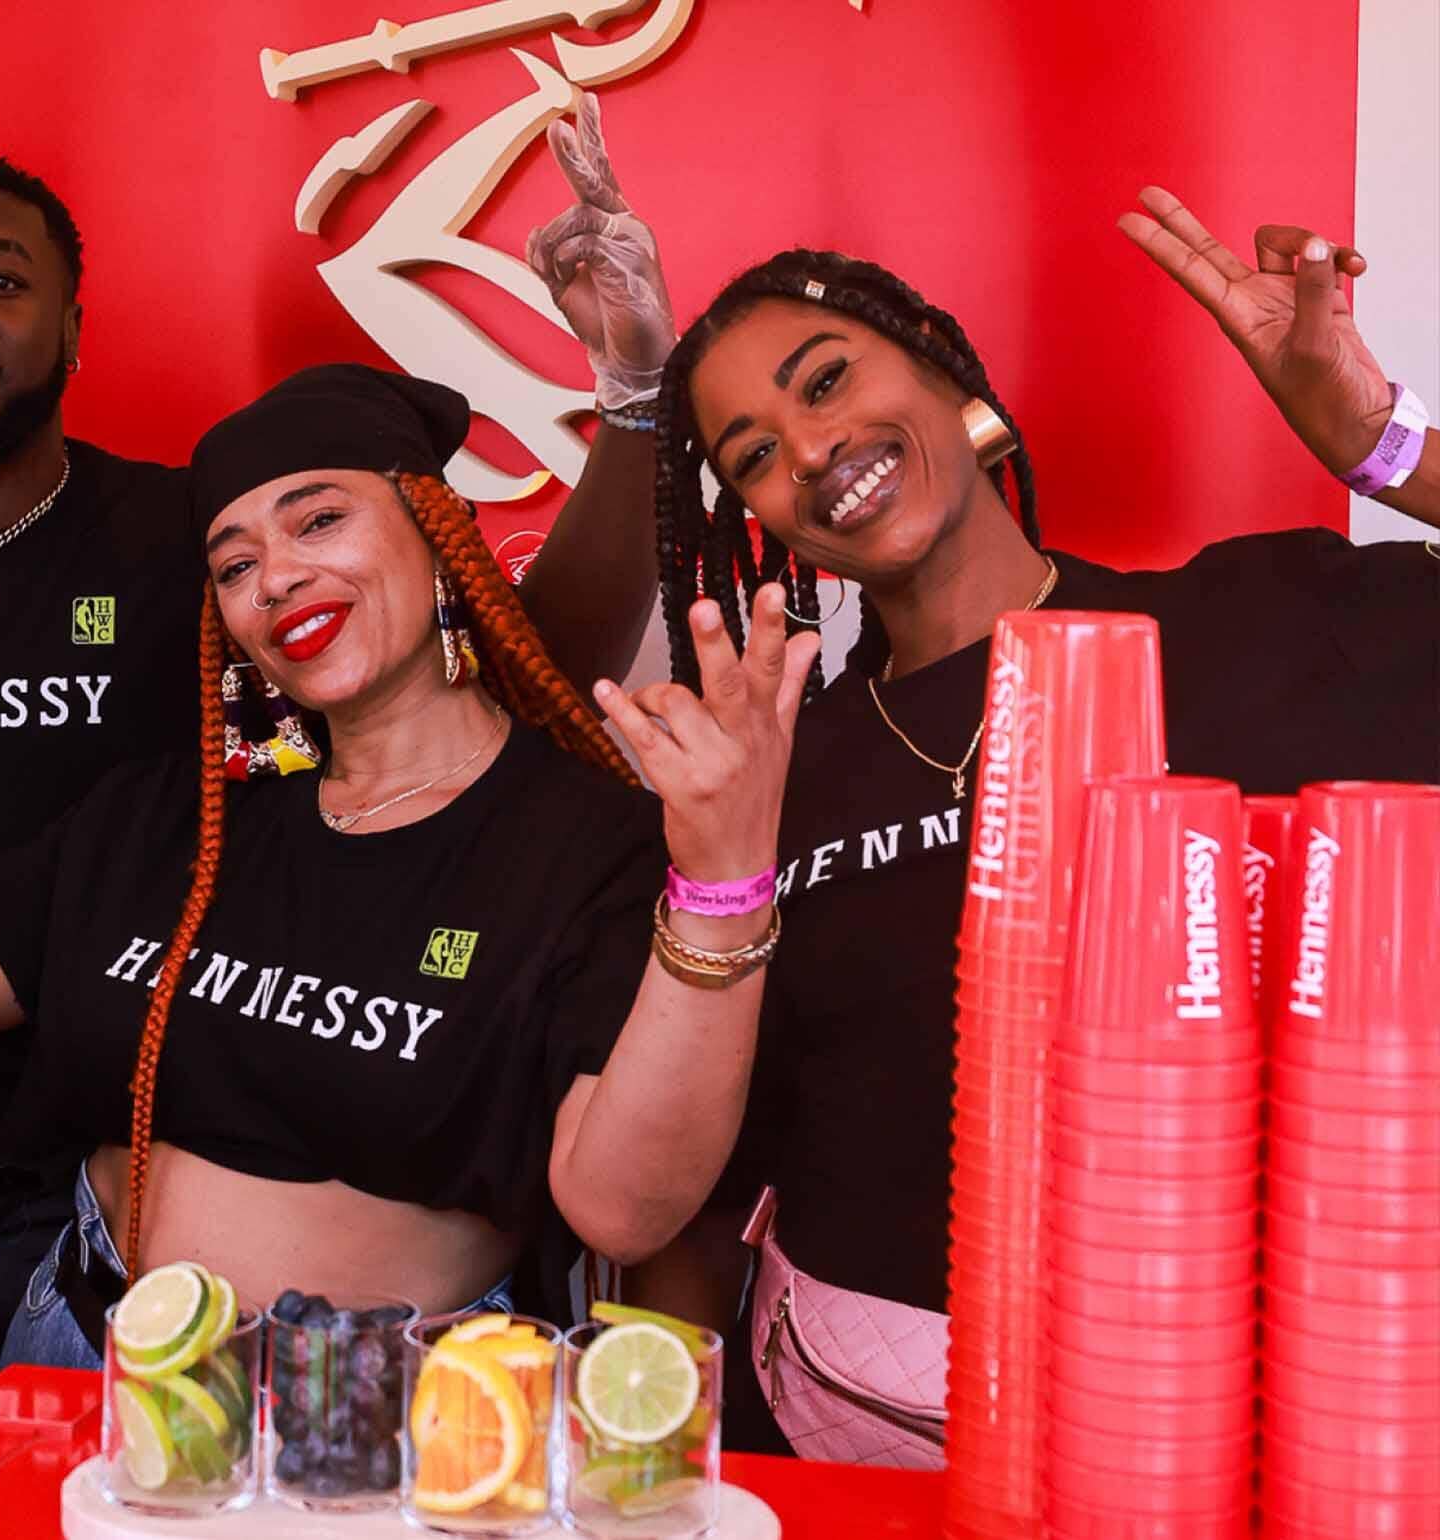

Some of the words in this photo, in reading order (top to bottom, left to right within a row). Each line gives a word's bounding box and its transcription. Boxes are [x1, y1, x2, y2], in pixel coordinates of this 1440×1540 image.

[969, 651, 1025, 901] Hennessy
[105, 937, 443, 1061] HNNESSY
[1176, 829, 1222, 1019] Hennessy
[1289, 828, 1341, 1019] Hennessy
